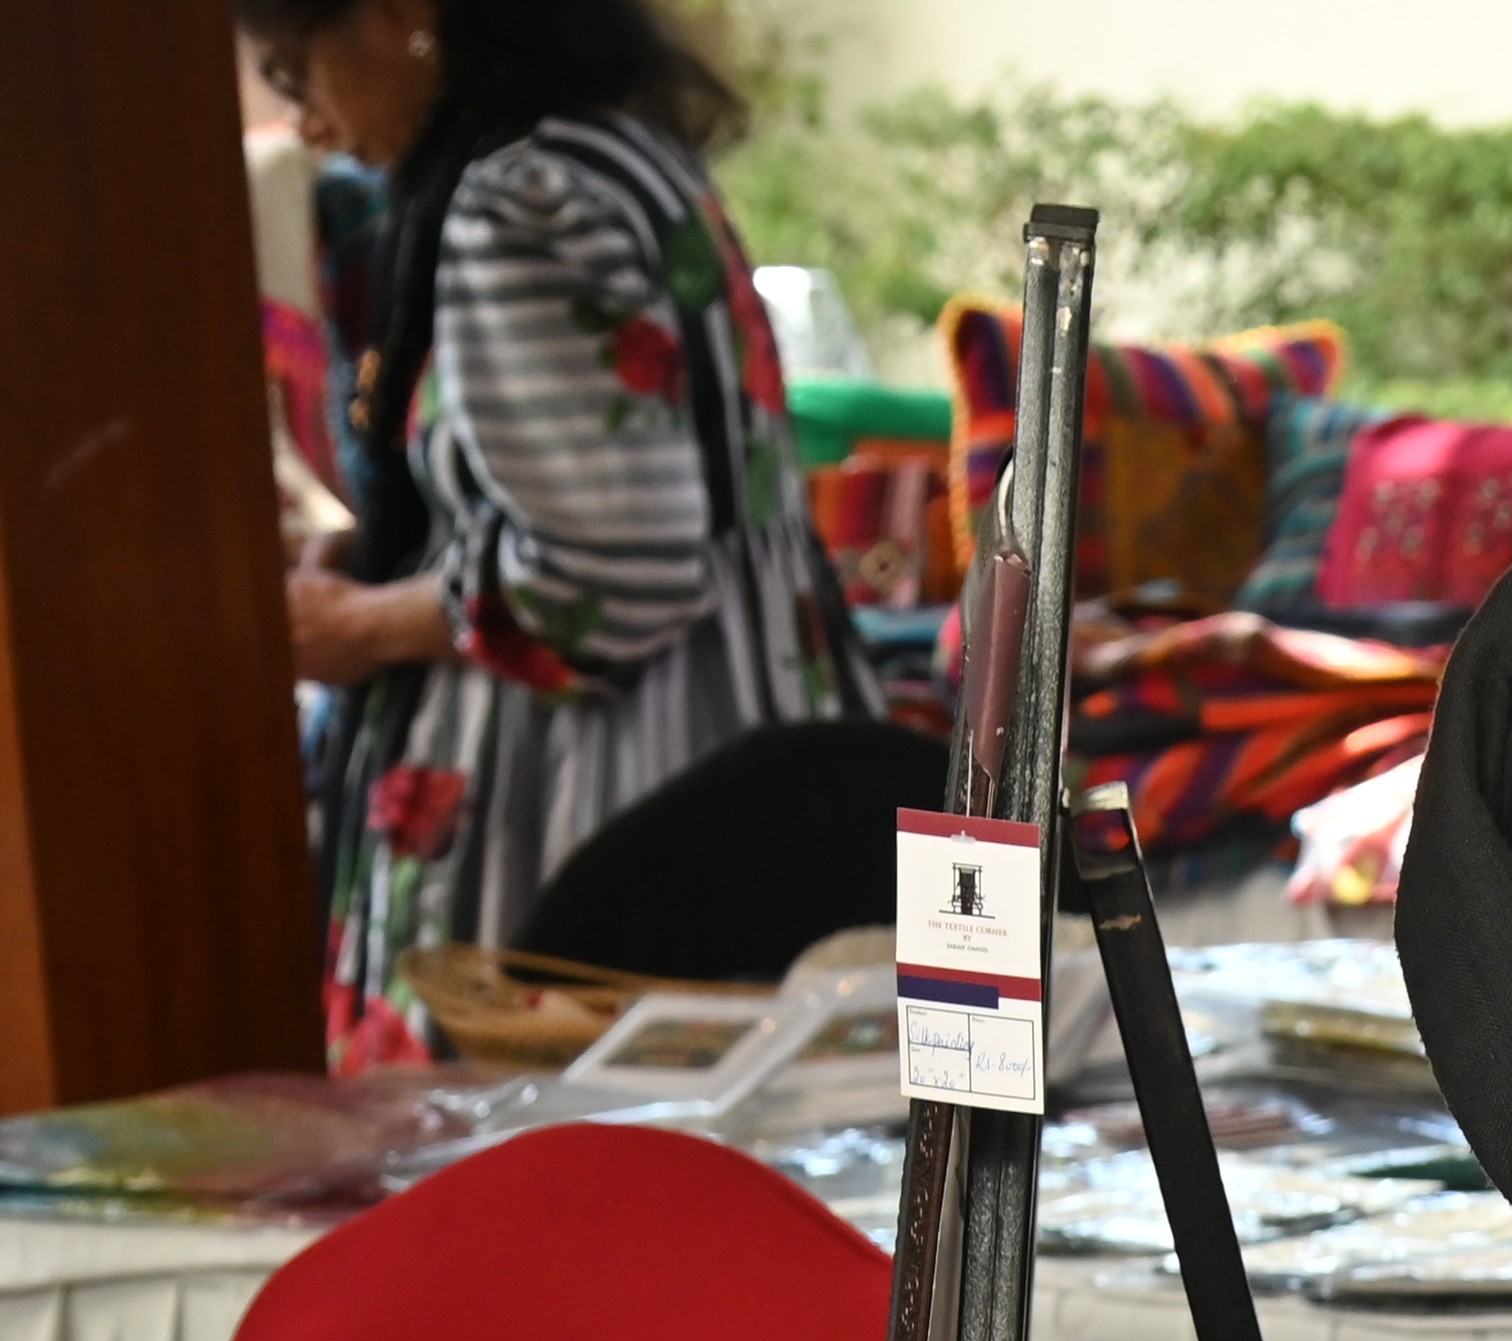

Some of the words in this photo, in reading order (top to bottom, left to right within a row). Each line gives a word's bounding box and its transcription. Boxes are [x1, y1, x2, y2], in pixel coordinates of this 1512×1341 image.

[928, 920, 942, 929] THE
[945, 922, 974, 933] TEXTILE
[976, 926, 1008, 937] CORNER
